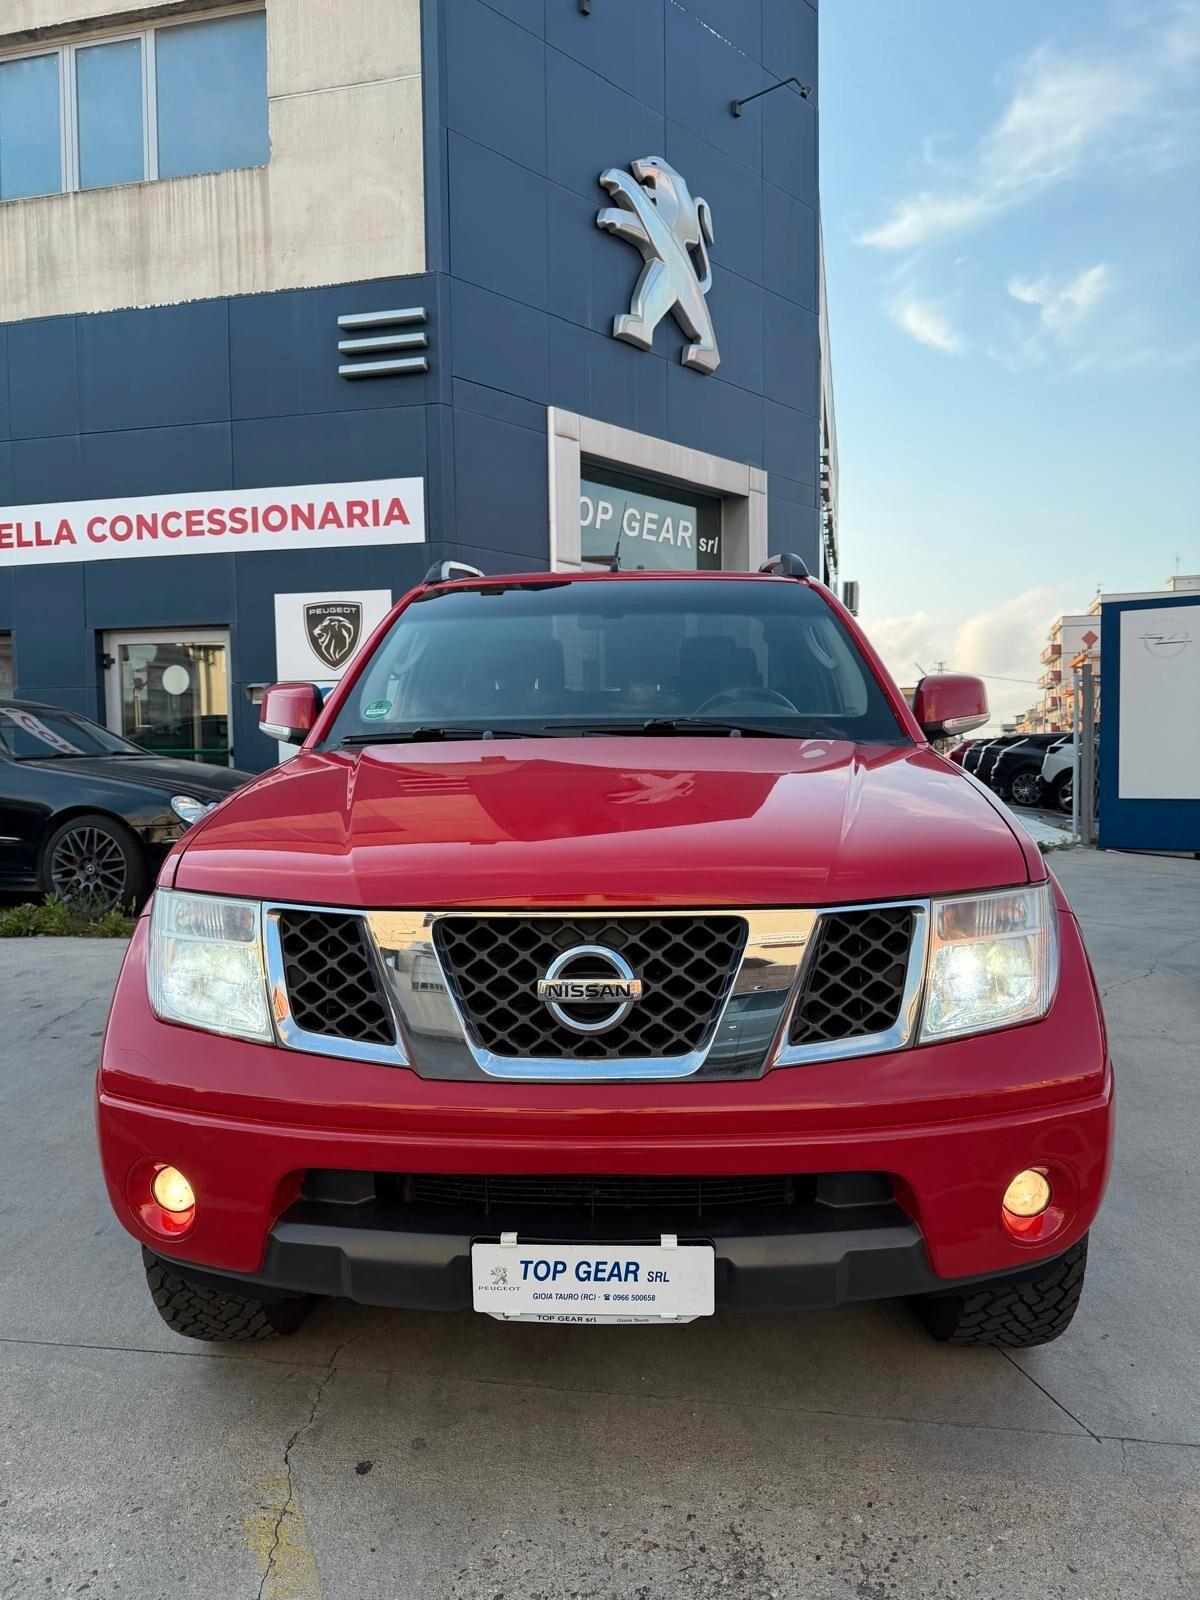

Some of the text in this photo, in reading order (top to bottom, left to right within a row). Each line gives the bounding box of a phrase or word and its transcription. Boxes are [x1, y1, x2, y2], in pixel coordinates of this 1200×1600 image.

[86, 497, 410, 543] CONCESSIONARIA
[622, 508, 693, 549] GEAR
[698, 537, 719, 555] srl
[309, 607, 357, 615] PEUGEOT
[548, 984, 631, 998] NISSAN
[519, 1260, 670, 1283] TOP GEAR SRL
[532, 1293, 553, 1301] GIOIA
[555, 1293, 579, 1301] TAURO
[580, 1293, 597, 1302] (RC)
[613, 1294, 630, 1302] 0966
[631, 1294, 656, 1302] 500658
